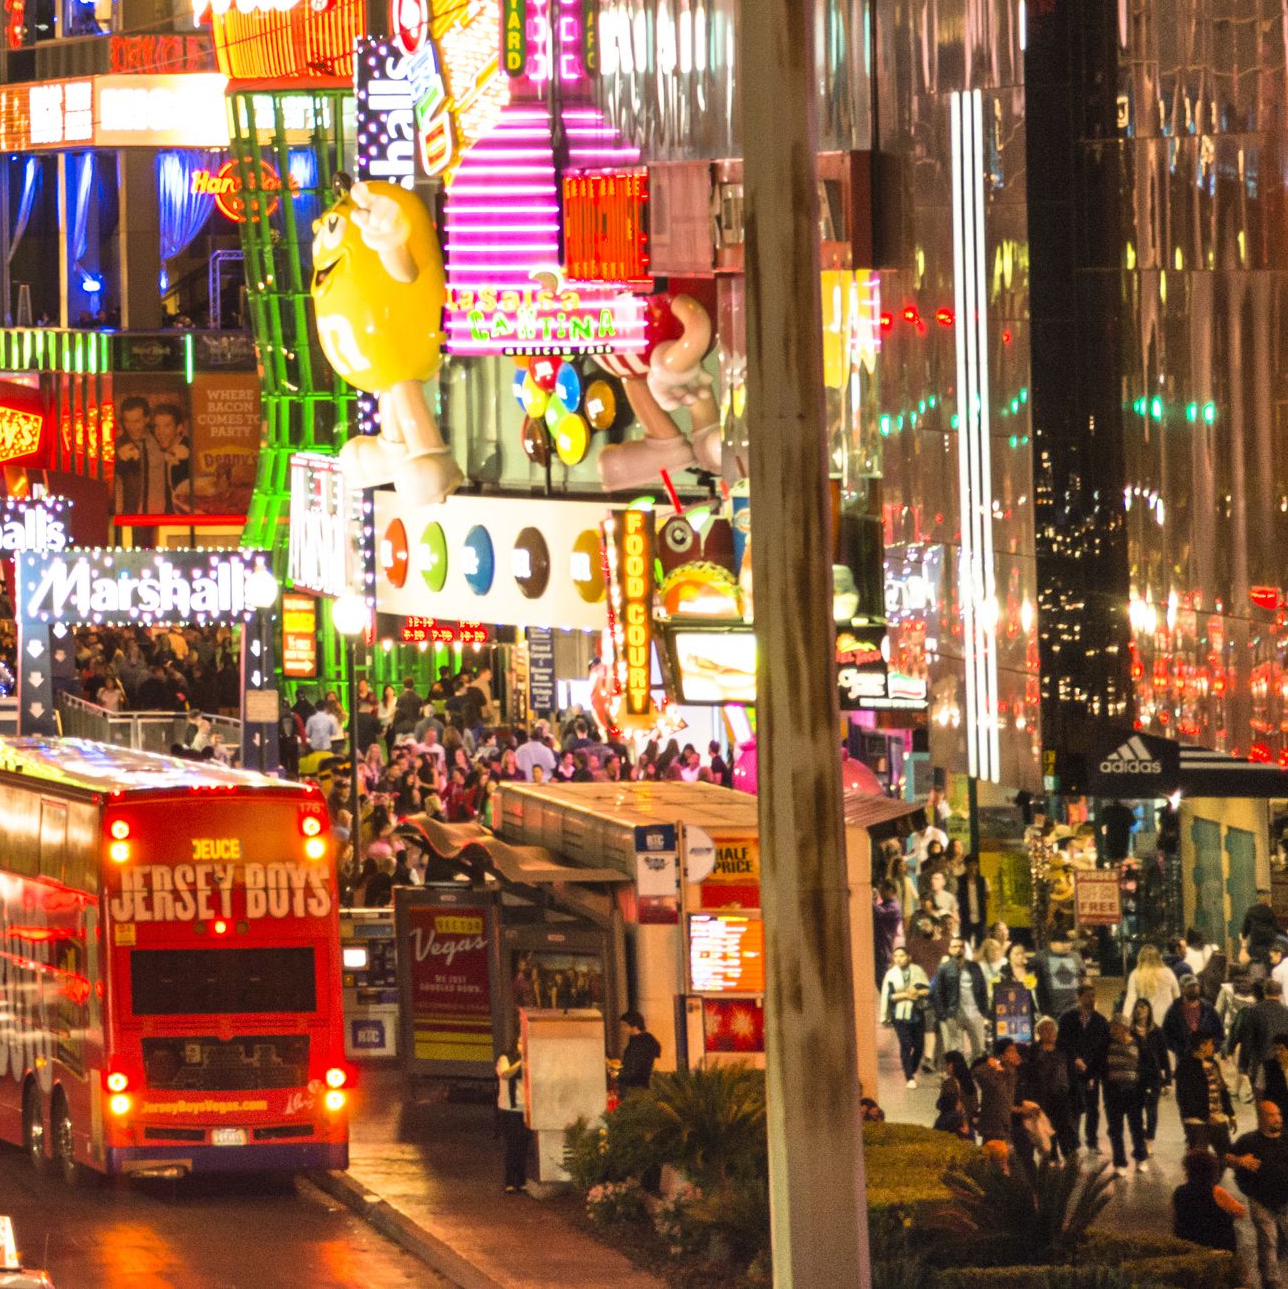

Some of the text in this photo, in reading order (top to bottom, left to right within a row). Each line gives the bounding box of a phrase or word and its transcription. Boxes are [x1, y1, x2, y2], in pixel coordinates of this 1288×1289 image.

[466, 307, 617, 342] CANTINA
[207, 389, 255, 400] WHERE
[206, 402, 254, 413] BACON
[197, 414, 243, 425] COMES
[210, 426, 252, 438] PARTY
[626, 513, 645, 598] FOOD
[626, 604, 646, 709] COURT
[1100, 760, 1162, 774] adidas
[716, 847, 749, 861] HALF
[712, 860, 753, 874] PRICE
[111, 862, 332, 922] JERSEY BOYS
[1080, 901, 1117, 911] FREE
[409, 927, 488, 966] Vegas
[141, 1099, 268, 1114] JerseyBoysVegas.com
